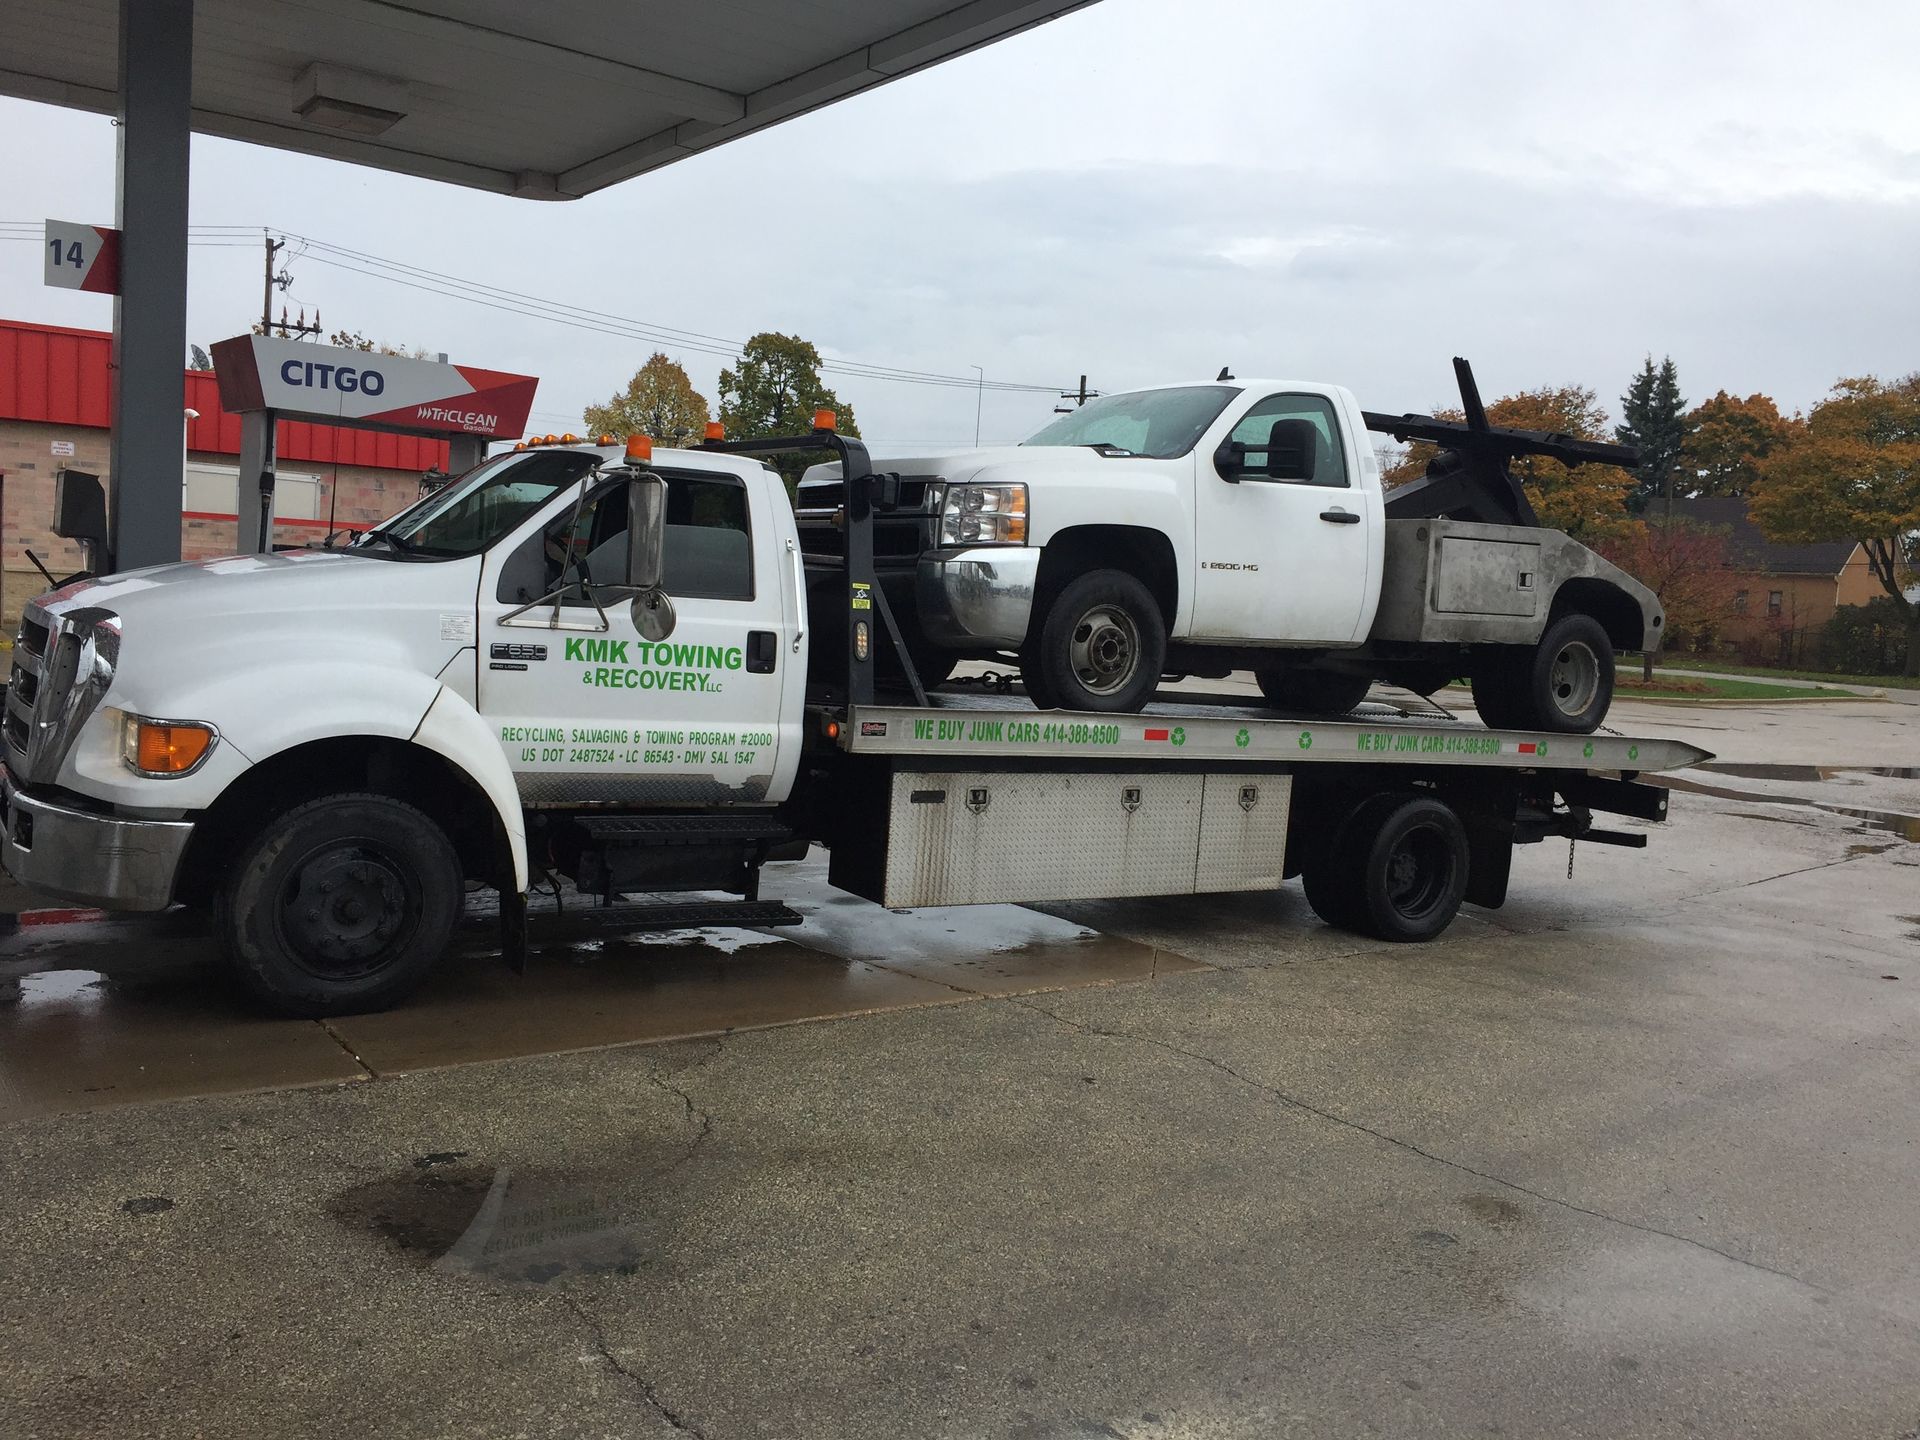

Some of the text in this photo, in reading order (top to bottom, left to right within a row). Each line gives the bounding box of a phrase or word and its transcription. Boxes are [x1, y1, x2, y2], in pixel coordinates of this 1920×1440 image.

[50, 238, 84, 269] 14
[280, 359, 385, 396] CITGO
[431, 407, 498, 428] TriCLEAN
[463, 423, 495, 433] Gasoline
[565, 638, 742, 670] KMK TOWING
[706, 683, 723, 693] LLC
[502, 727, 773, 746] RECYCLING, SALVAGING & TOWING PROGRAM #2000
[914, 719, 1119, 744] WE BUY JUNK CARS 414-388-8500
[1358, 733, 1500, 754] WE BUY JUNK CARS 414-388-8500
[522, 748, 756, 764] US DOT 2487524 LC 86543 DMV SAL 1547
